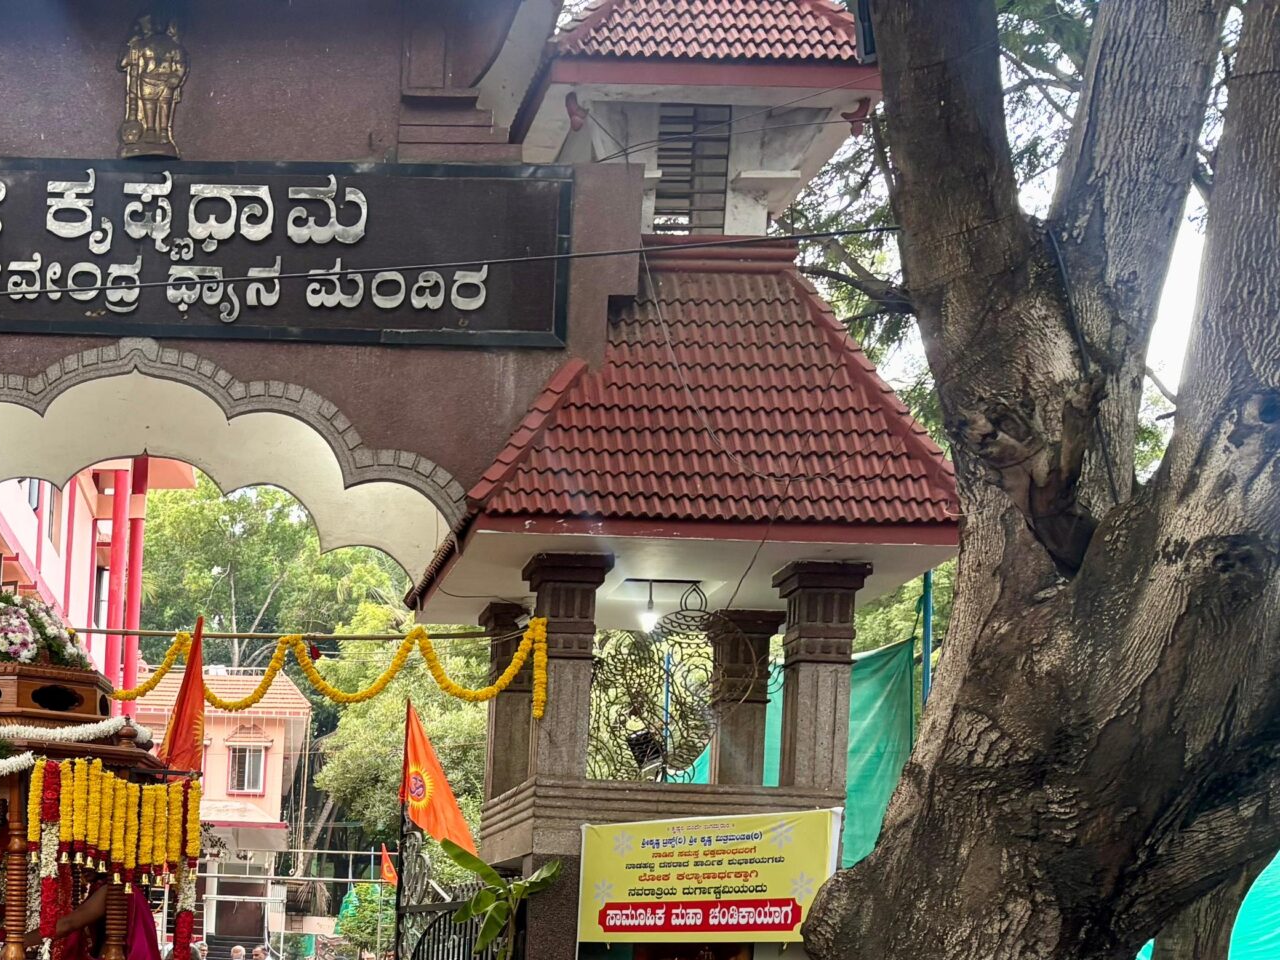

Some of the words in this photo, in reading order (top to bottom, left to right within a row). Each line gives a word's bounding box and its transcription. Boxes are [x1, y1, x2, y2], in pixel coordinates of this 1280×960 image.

[46, 168, 367, 261] ಕೃಷ್ಣಧಾಮ
[166, 256, 282, 322] ಧ್ಯಾನ
[306, 258, 489, 311] ಮಂದಿರ
[606, 903, 666, 927] ಸಾಮೂಹಿಕ
[671, 903, 703, 926] ಮಹಾ
[708, 900, 793, 926] ಚಂಡಿಕಾಯಾಗ
[628, 885, 677, 899] ನವರಾತ್ರಿಯ
